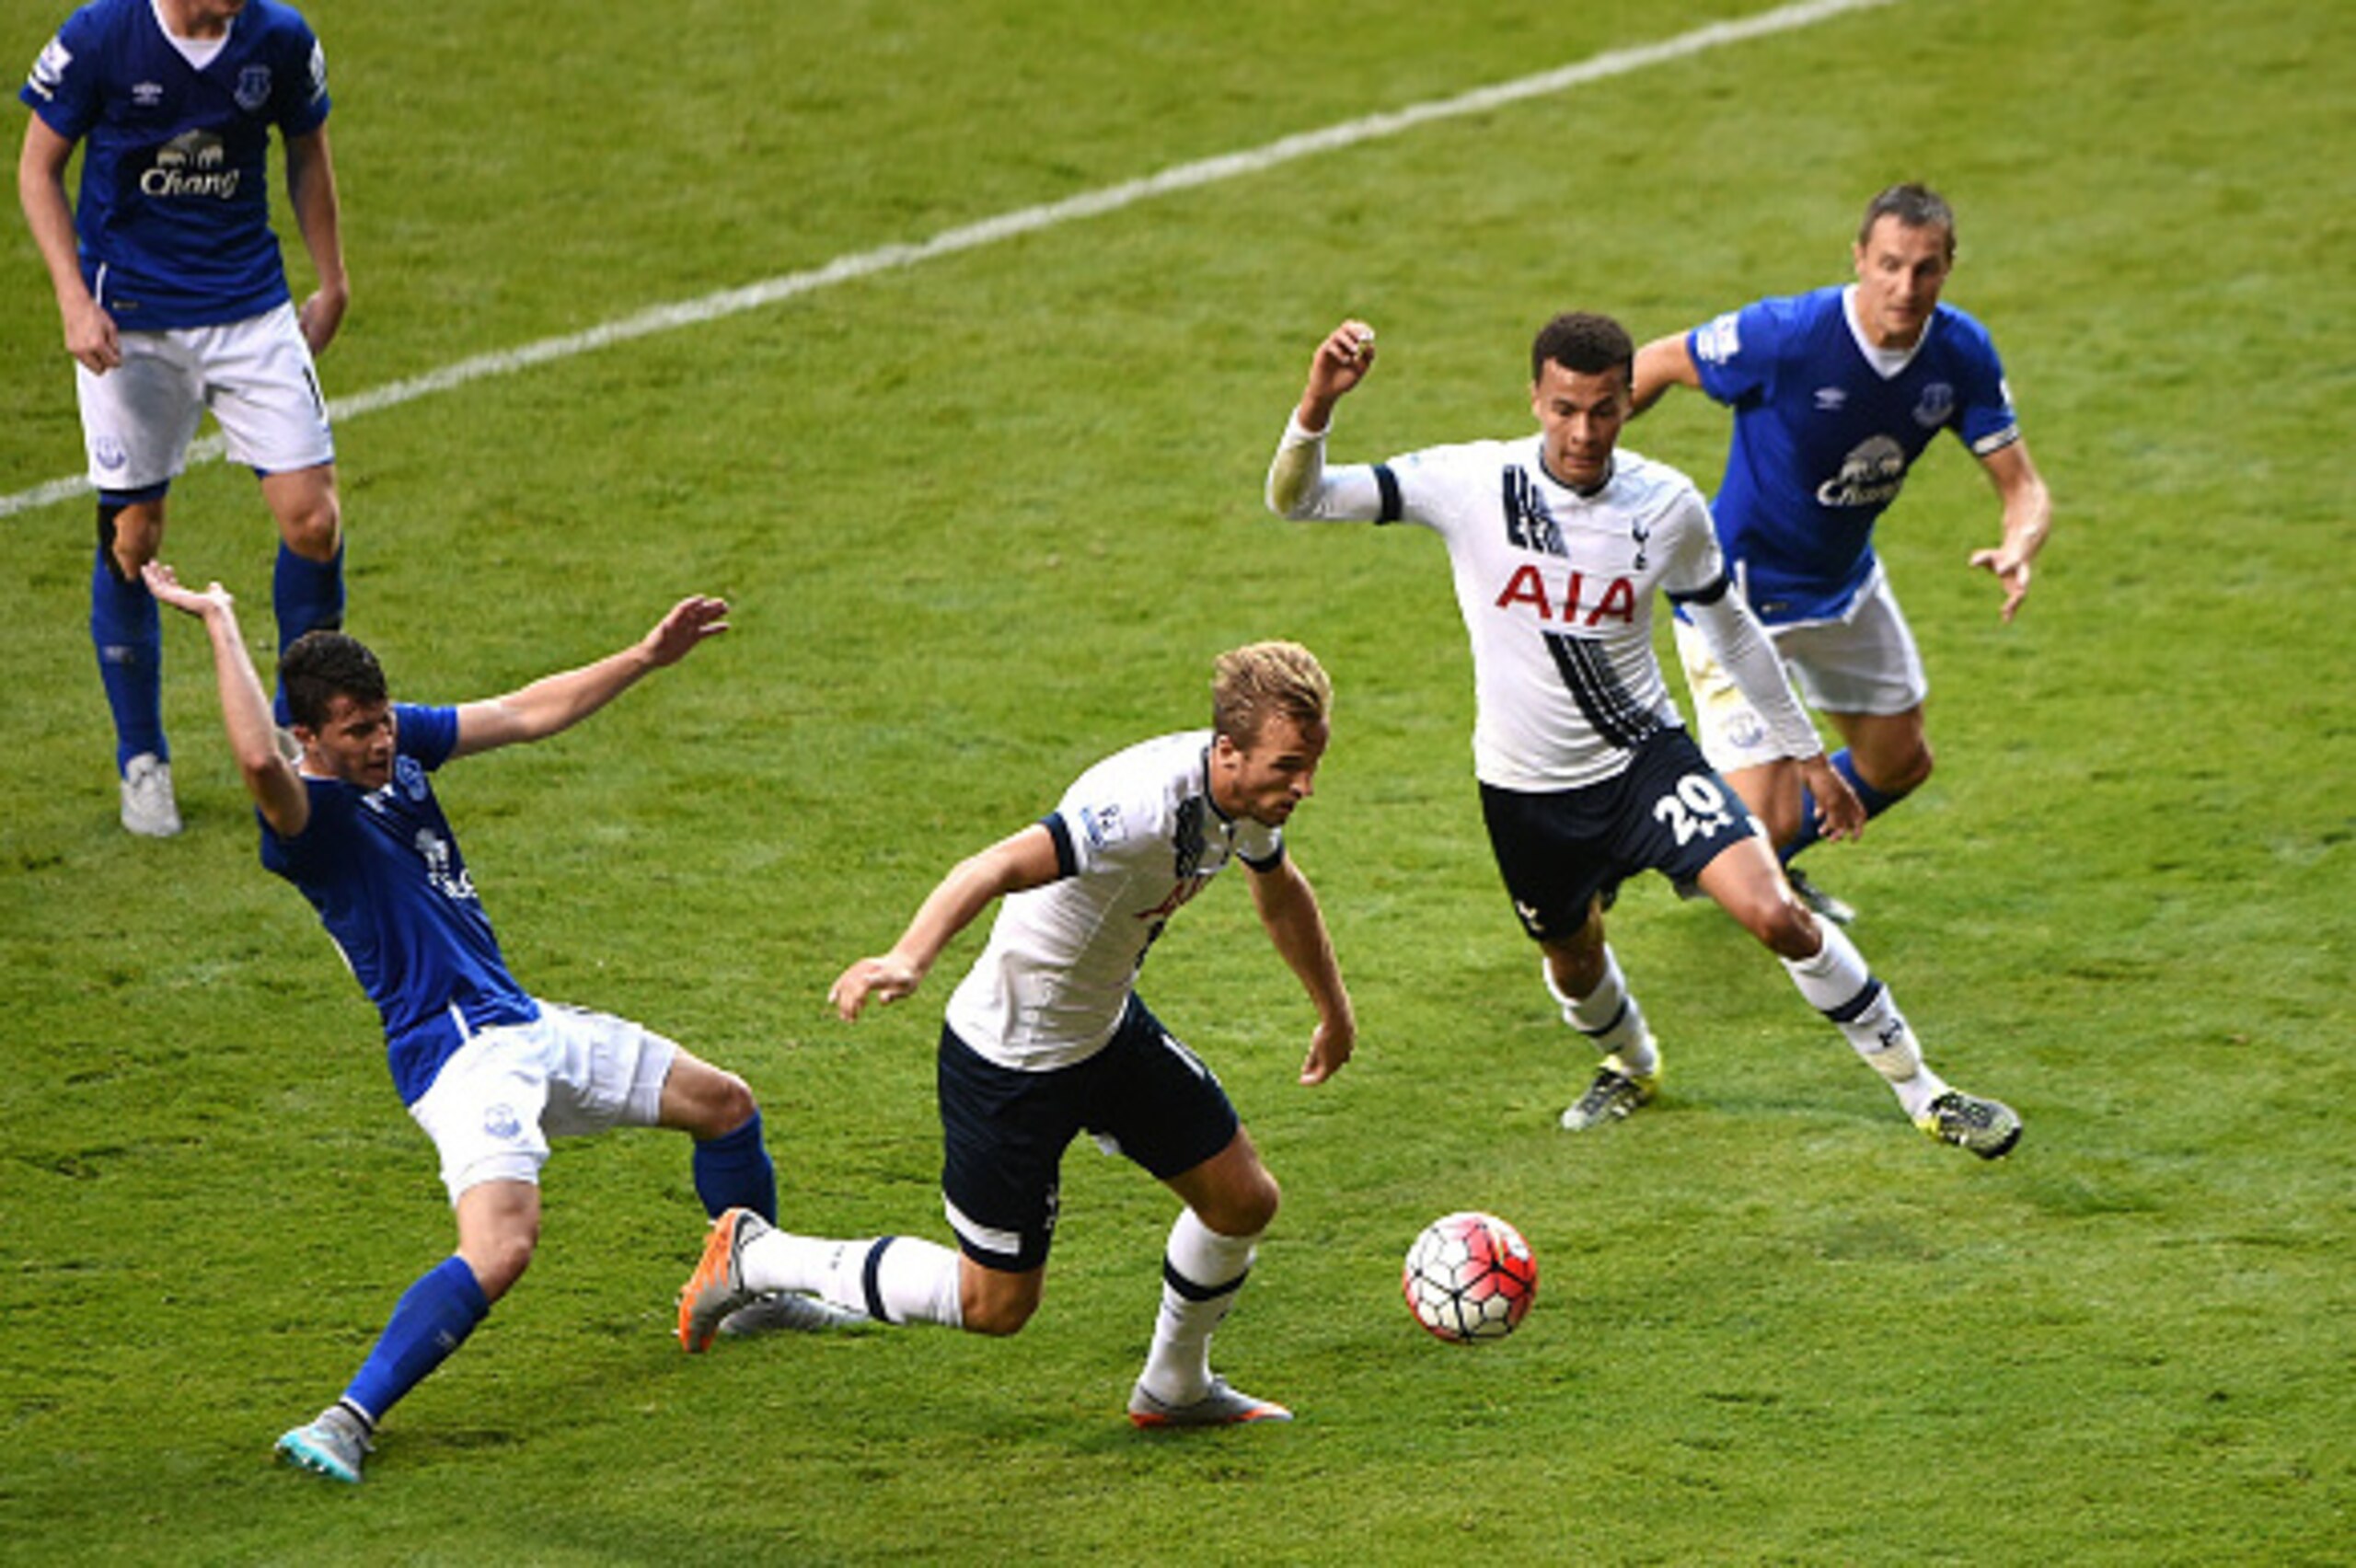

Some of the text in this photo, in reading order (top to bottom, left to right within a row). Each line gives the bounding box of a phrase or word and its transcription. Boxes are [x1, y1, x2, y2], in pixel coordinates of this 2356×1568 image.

[140, 167, 240, 199] Chang
[1496, 564, 1634, 627] AIA
[1653, 774, 1724, 846] 20
